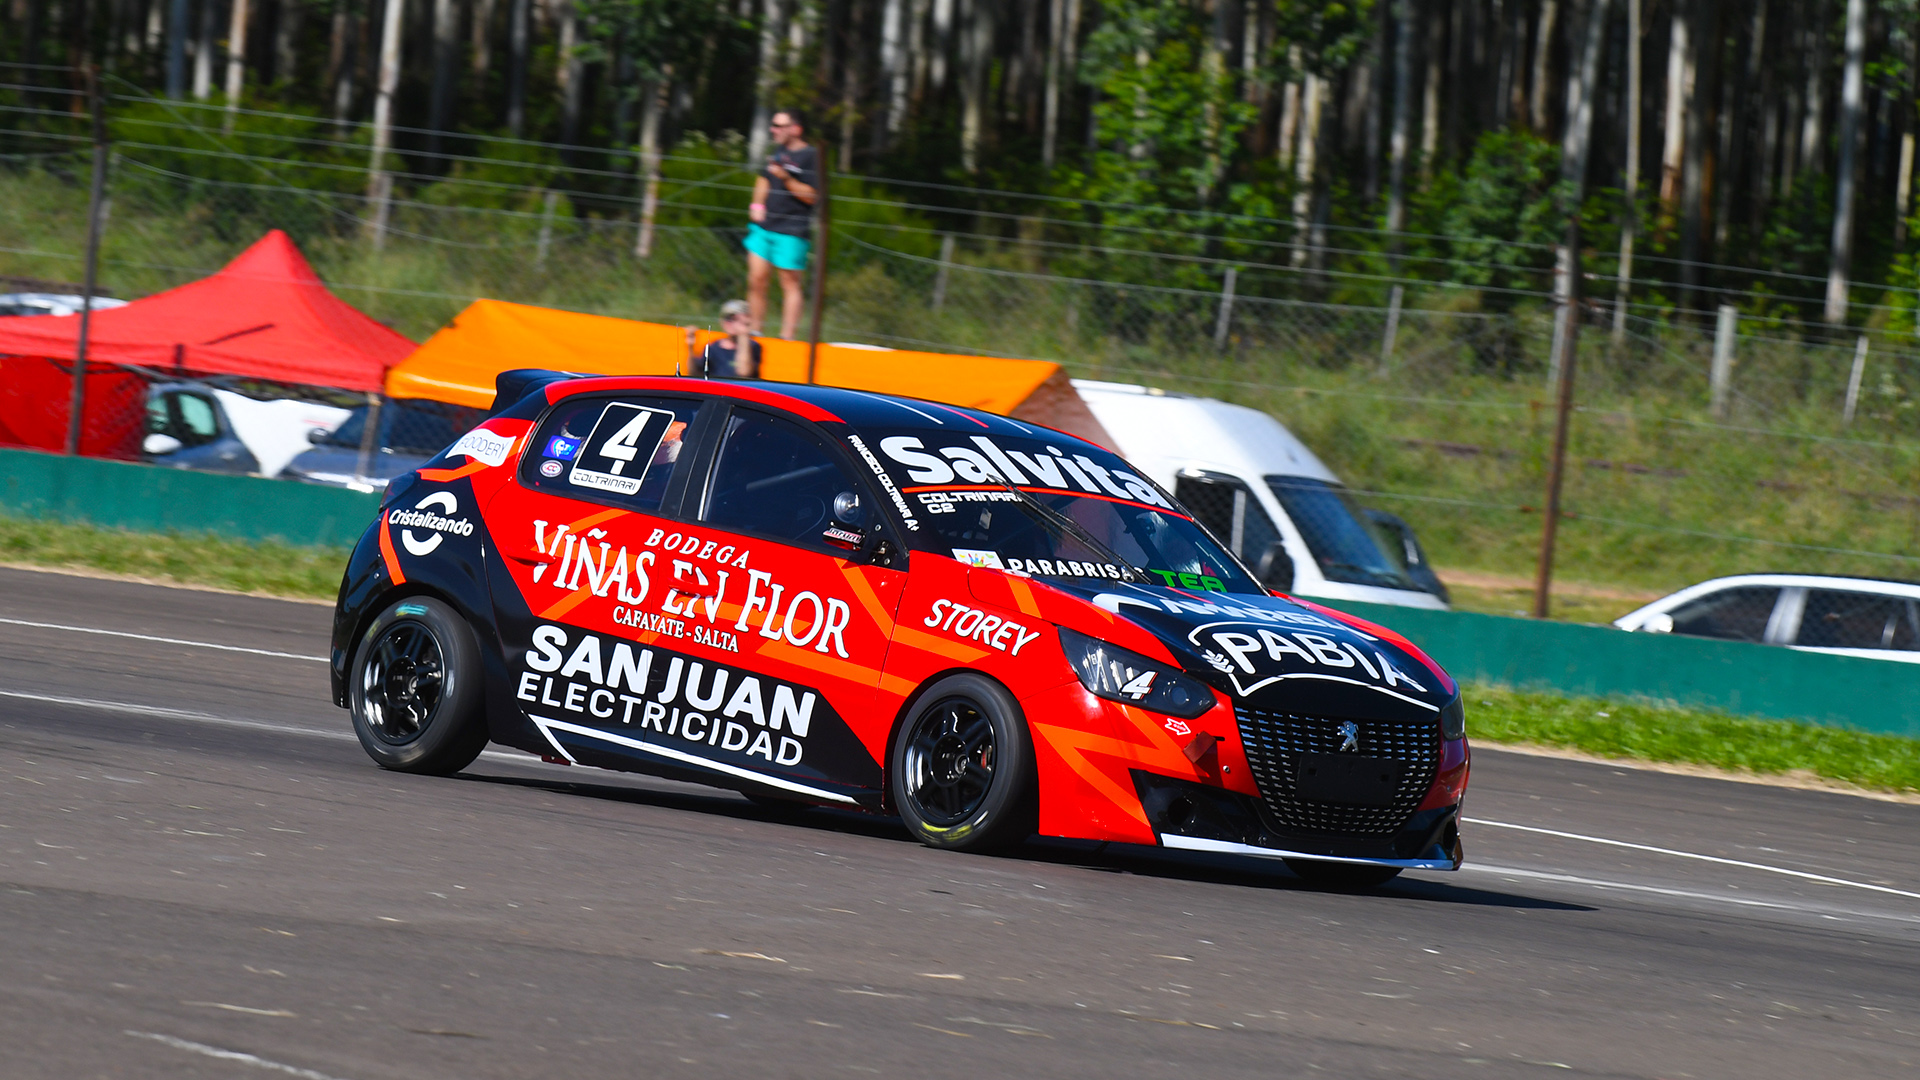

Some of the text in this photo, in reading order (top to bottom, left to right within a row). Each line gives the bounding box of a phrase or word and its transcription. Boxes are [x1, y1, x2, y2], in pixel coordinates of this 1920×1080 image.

[599, 410, 652, 475] 4
[573, 471, 637, 491] COLTRINARI
[880, 436, 1175, 510] Salvita
[388, 509, 474, 537] Cristalizando
[927, 502, 956, 514] C2
[644, 528, 751, 569] BODEGA
[1007, 558, 1144, 583] PARABRIS
[533, 519, 656, 606] VIÑAS
[734, 567, 852, 659] FLOR
[612, 606, 685, 640] CAFAYATE
[693, 625, 739, 653] SALTA
[923, 598, 1040, 656] STOREY
[525, 624, 816, 738] SAN JUAN
[1121, 670, 1158, 700] 4
[1211, 628, 1428, 692] PABIA
[516, 671, 804, 767] ELECTRICIDAD
